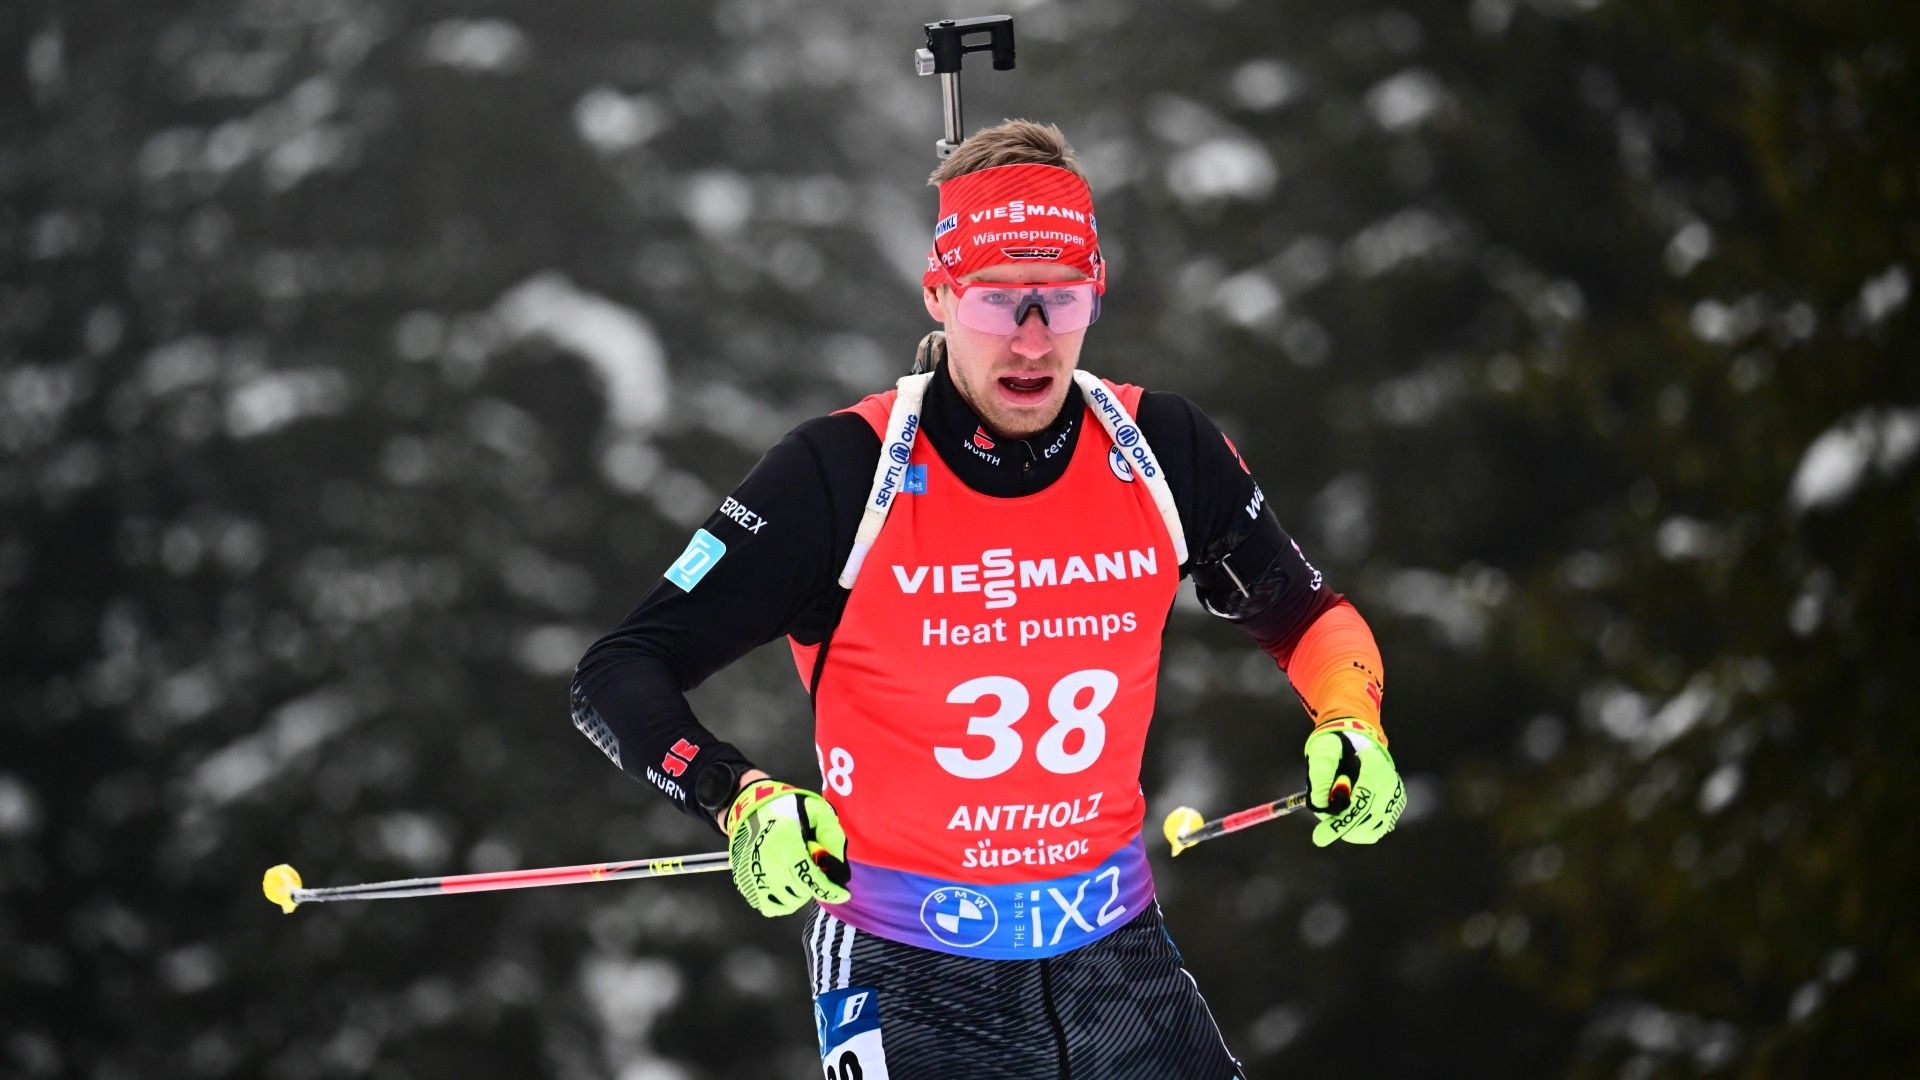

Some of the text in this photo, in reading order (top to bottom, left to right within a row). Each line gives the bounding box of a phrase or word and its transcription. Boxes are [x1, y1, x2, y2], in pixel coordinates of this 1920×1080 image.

[970, 200, 1085, 224] VIESSMANN
[972, 229, 1085, 246] Wärmepumpen
[875, 414, 918, 508] SENFTL OHG
[1091, 388, 1156, 478] SENFTL OHG
[892, 547, 1158, 609] VIESSMANN
[922, 610, 1138, 647] Heat pumps
[933, 668, 1119, 780] 38
[946, 792, 1103, 831] ANTHOLZ
[933, 890, 988, 909] BMW
[1013, 892, 1025, 949] THE NEW
[1030, 865, 1127, 948] iX2
